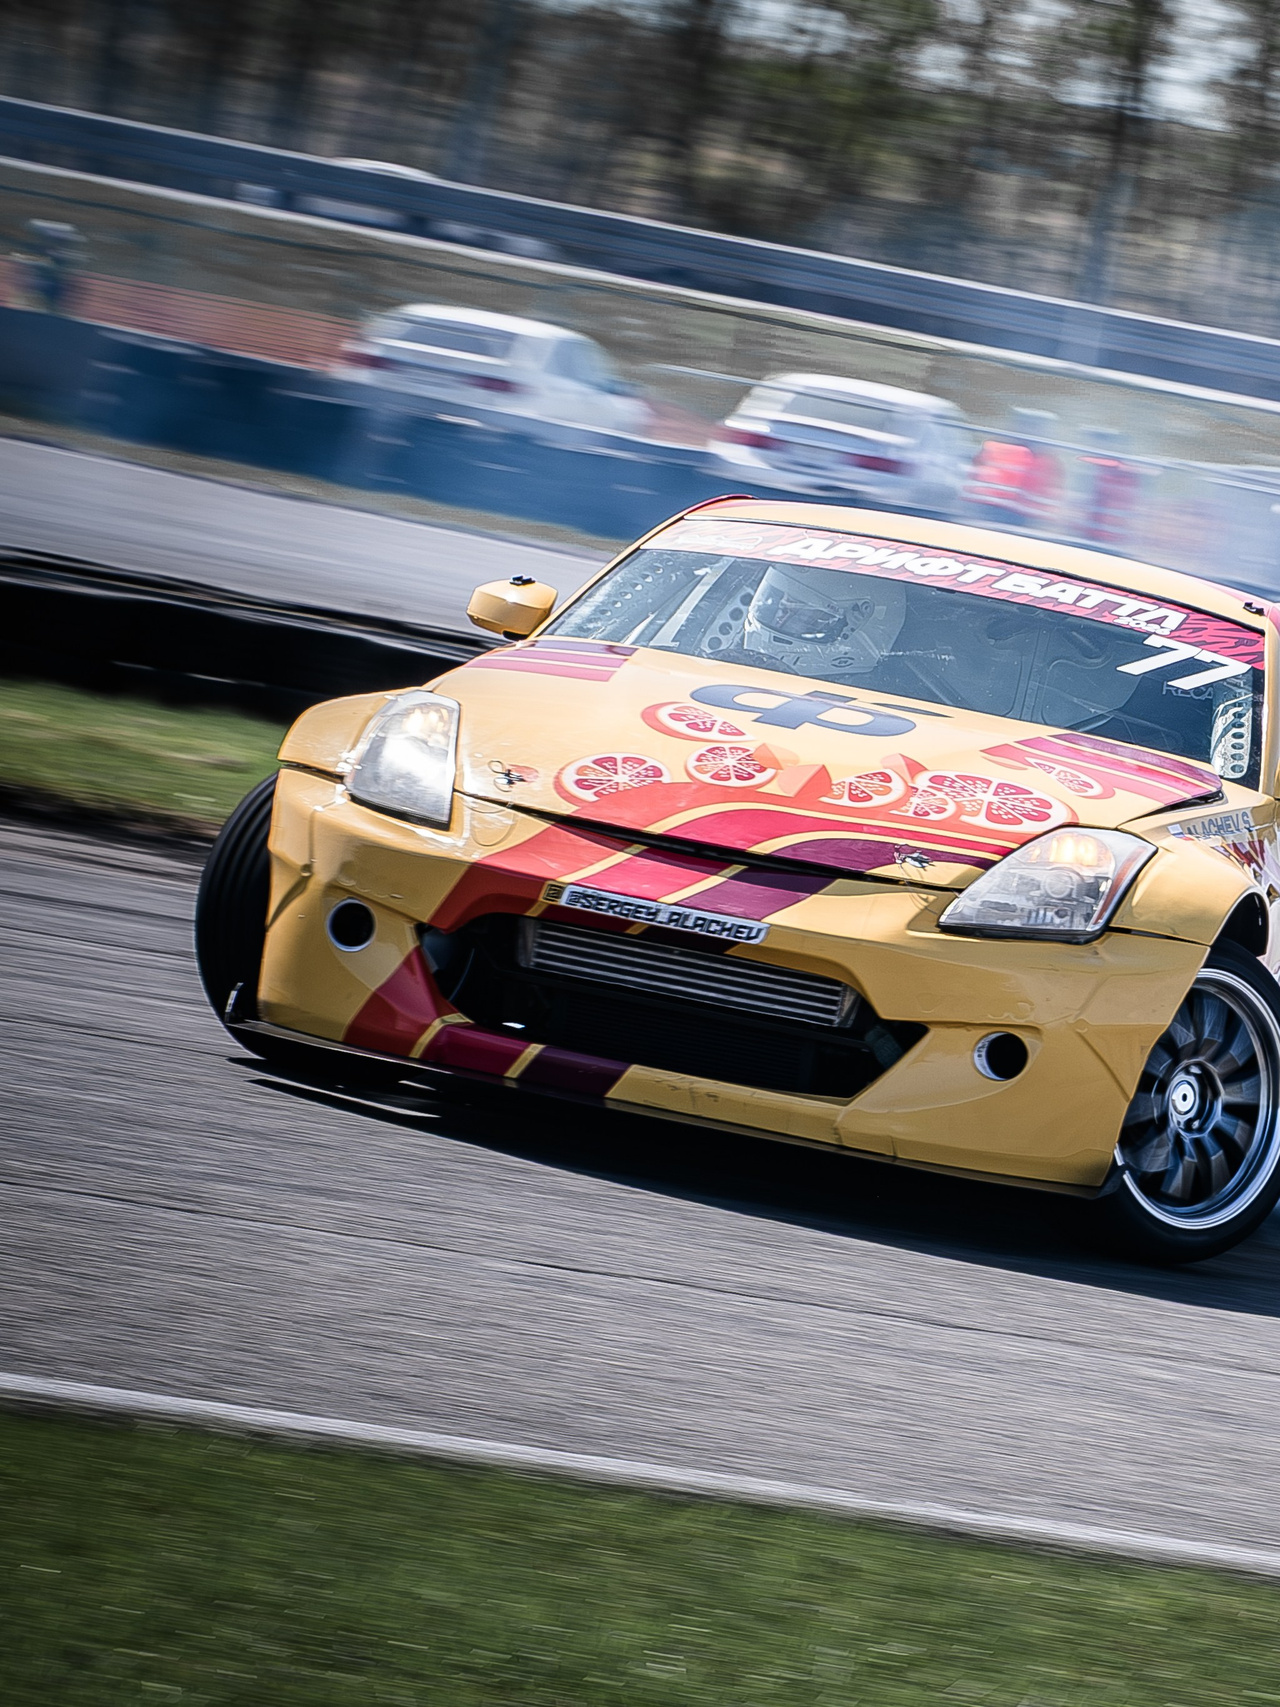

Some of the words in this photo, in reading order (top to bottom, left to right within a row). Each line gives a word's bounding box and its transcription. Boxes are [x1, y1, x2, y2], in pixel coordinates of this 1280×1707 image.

[766, 537, 1006, 582] ДРИФТ
[991, 572, 1187, 631] БАТТЛ
[1116, 634, 1252, 690] 77
